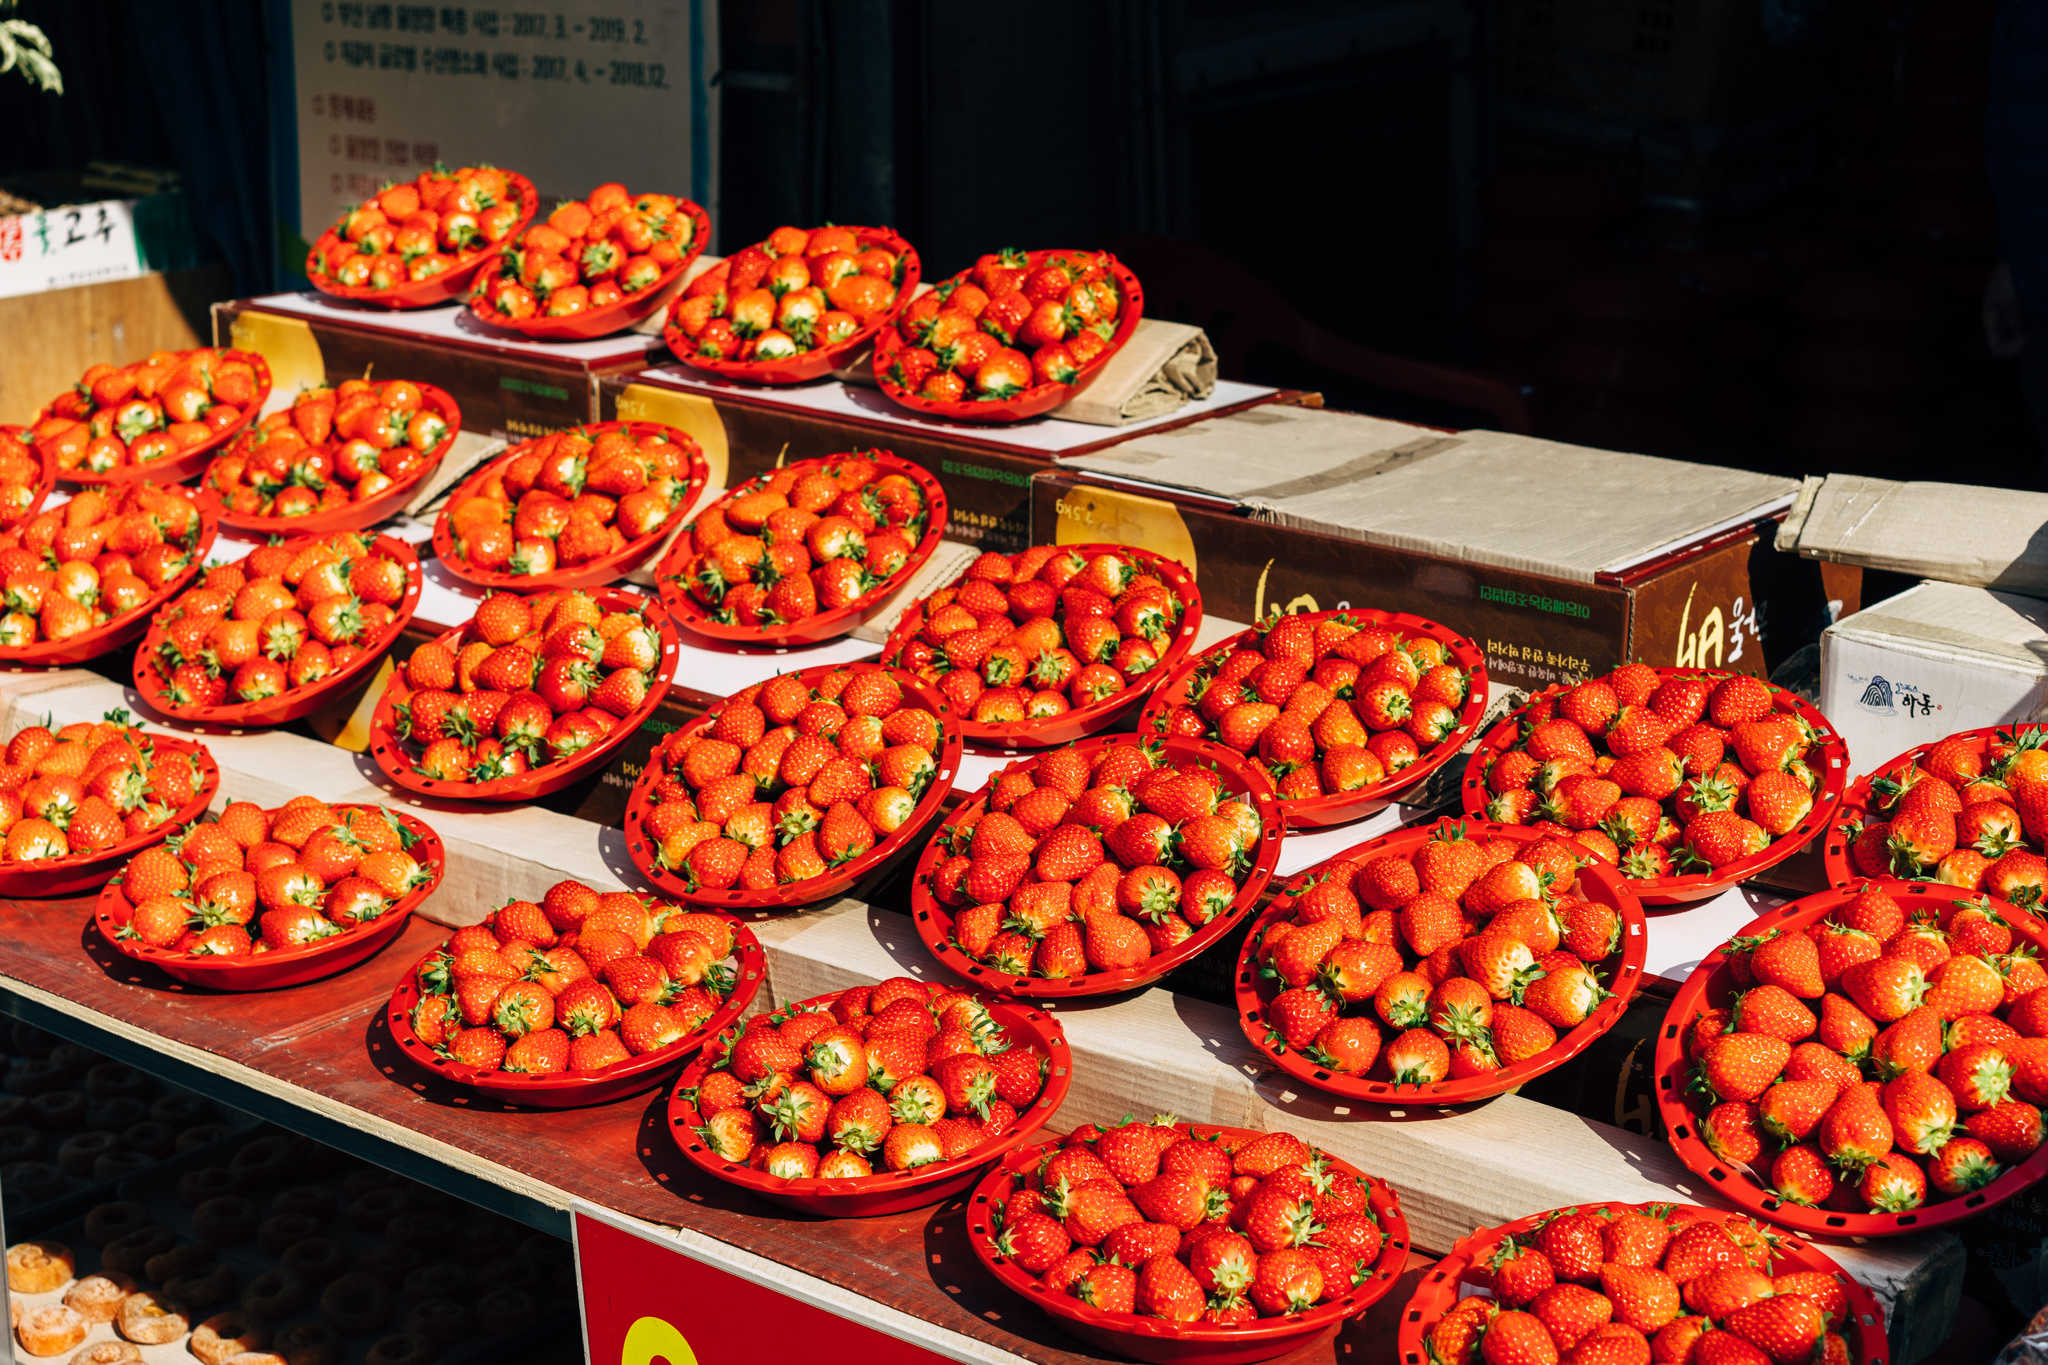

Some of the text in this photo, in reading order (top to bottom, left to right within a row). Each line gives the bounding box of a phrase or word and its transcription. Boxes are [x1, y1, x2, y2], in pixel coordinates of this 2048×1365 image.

[1055, 498, 1094, 526] 7.5kg
[1486, 638, 1592, 674] 우리가족 안심 먹거리
[1488, 656, 1526, 676] 토양에서
[1527, 665, 1557, 682] 비옥한
[1902, 692, 1936, 719] 하동
